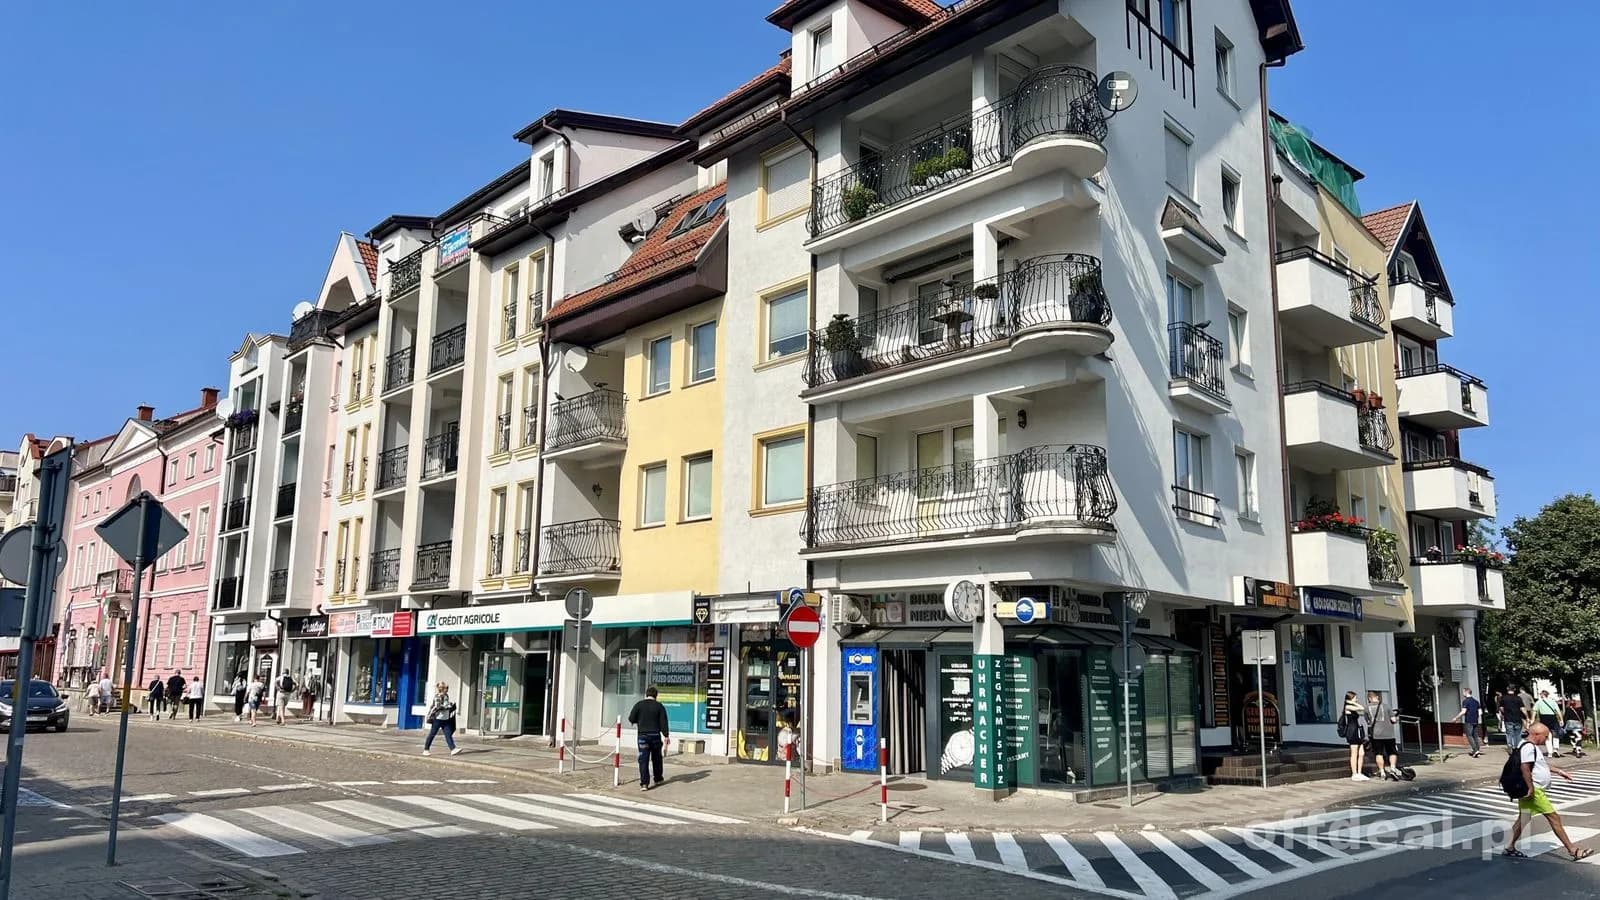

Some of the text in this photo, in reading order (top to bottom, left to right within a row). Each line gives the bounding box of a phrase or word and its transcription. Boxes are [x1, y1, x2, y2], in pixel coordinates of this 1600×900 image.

[438, 612, 500, 626] CRÉDIT AGRICOLE
[978, 660, 987, 783] UHRMACHER
[995, 660, 1003, 784] ZEGARMISTRZ
